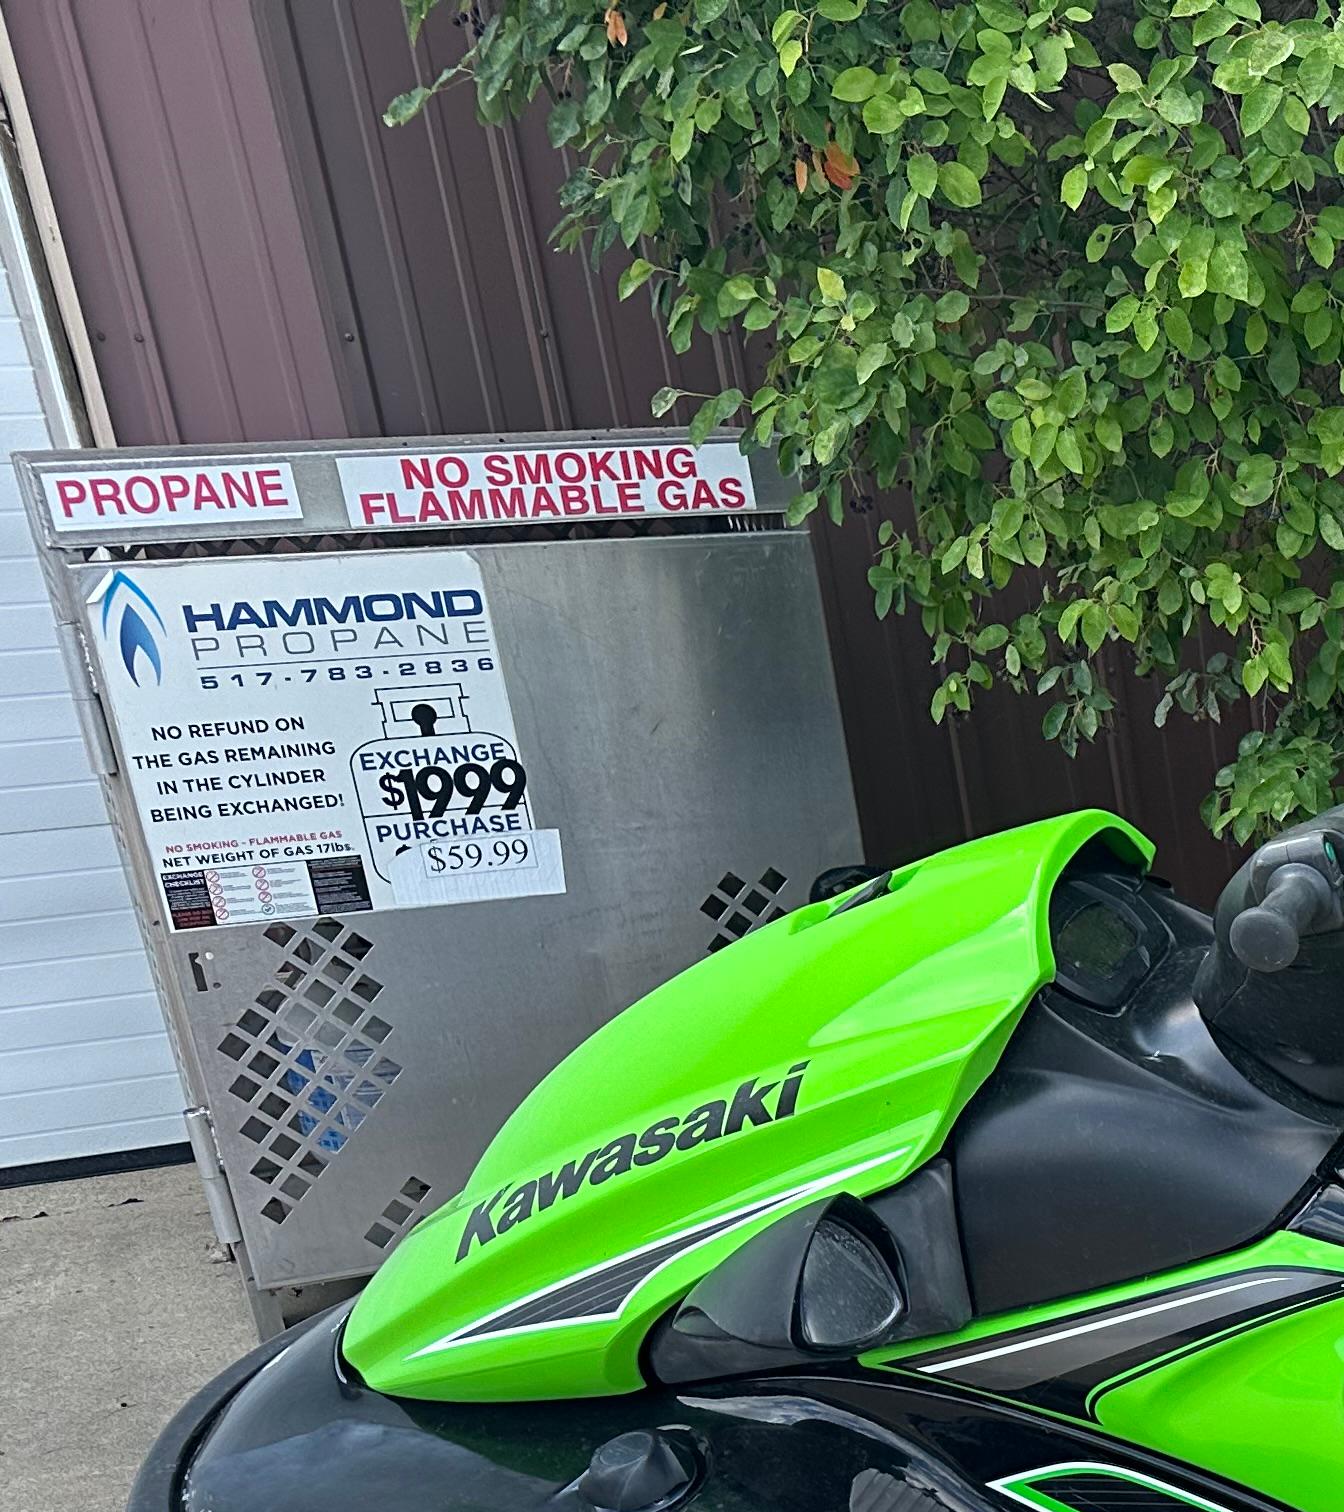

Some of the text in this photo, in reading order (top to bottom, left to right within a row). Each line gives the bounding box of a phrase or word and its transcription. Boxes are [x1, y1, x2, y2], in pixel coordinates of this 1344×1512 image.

[400, 447, 697, 489] NO SMOKING
[56, 469, 290, 519] PROPANE
[360, 476, 747, 525] FLAMMABLE GAS
[182, 589, 484, 633] HAMMOND
[191, 621, 490, 661] PROPANE
[200, 657, 494, 690] 517-783-2836
[151, 716, 305, 741] NO REFUND ON
[132, 741, 336, 770] THE GAS REMAINING
[359, 743, 507, 771] EXCHANGE
[156, 768, 326, 795] IN THE CYLINDER
[150, 793, 345, 823] BEING EXCHANGED!
[165, 844, 183, 854] NO
[186, 839, 239, 852] SMOKING
[248, 831, 317, 847] FLAMMABLE
[319, 830, 343, 840] GAS
[376, 814, 522, 843] PURCHASE
[162, 856, 191, 868] NET
[195, 850, 254, 865] WEIGHT
[259, 849, 280, 859] OF
[283, 844, 314, 856] GAS
[427, 838, 529, 873] $59.99
[455, 1060, 811, 1264] Kawasaki
